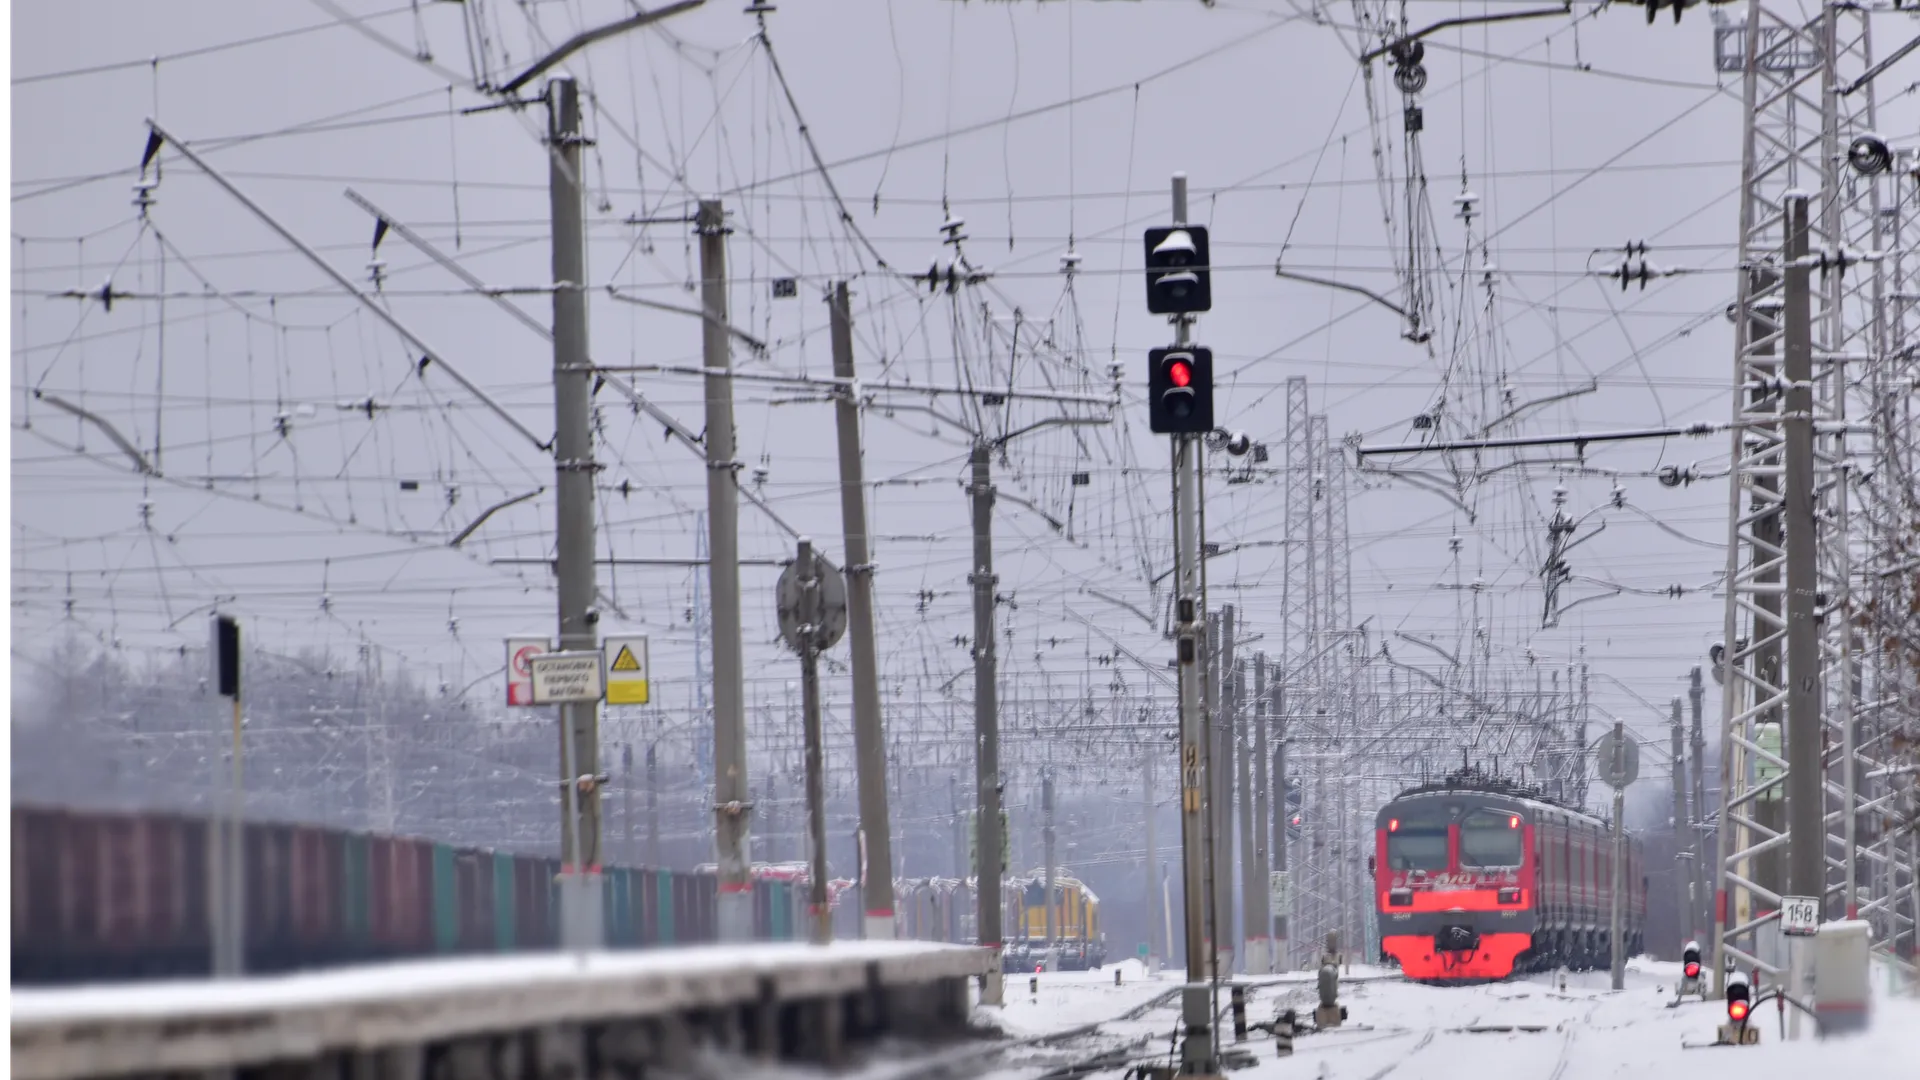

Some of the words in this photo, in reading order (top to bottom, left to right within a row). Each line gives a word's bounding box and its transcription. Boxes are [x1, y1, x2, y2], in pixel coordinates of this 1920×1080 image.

[537, 660, 594, 672] ОСТАНОВКА
[544, 672, 589, 684] ПЕРВОГО
[549, 685, 585, 697] ВАГОНА
[1788, 903, 1813, 923] 158
